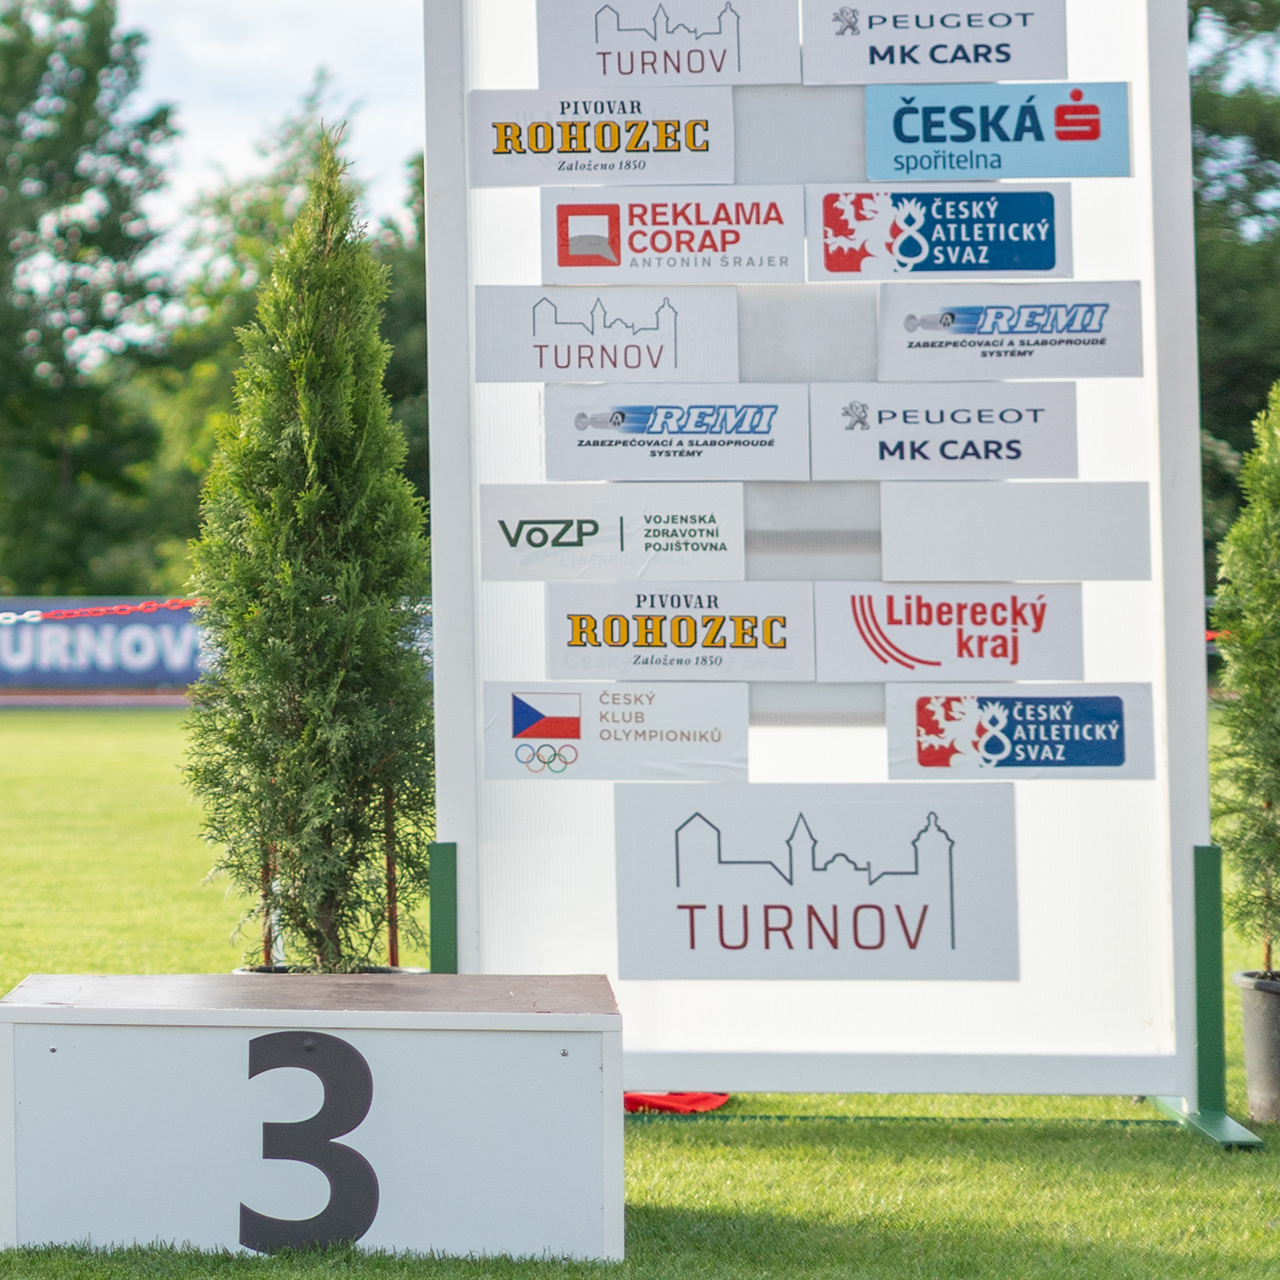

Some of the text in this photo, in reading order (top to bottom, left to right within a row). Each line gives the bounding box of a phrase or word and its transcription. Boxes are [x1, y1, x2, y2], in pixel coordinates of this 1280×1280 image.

[868, 12, 1035, 30] PEUGEOT
[596, 48, 728, 76] TURNOV
[869, 43, 1012, 65] MK CARS
[558, 99, 643, 116] PIVOVAR
[892, 95, 1046, 144] ČESKÁ
[492, 119, 710, 155] ROHOZEC
[557, 159, 647, 172] Založeno 1850
[893, 149, 1002, 174] spořitelna
[627, 201, 785, 227] REKLAMA
[930, 196, 999, 220] ČESKÝ
[930, 218, 1050, 242] ATLETICKÝ
[627, 228, 741, 254] CORAP
[628, 253, 790, 269] ANTONÍN ŠRAJER
[933, 245, 990, 265] SVAZ
[976, 302, 1110, 335] REMI
[906, 336, 1108, 348] ZABEZPEČOVACÍ A SLABOPROUDÉ
[532, 343, 664, 370] TURNOV
[980, 348, 1035, 358] SYSTÉMY
[645, 404, 779, 435] REMI
[877, 408, 1045, 425] PEUGEOT
[576, 437, 776, 448] ZABEZPEČOVACÍ A SLABOPROUDÉ
[649, 448, 704, 458] SYSTÉMY
[878, 439, 1023, 461] MK CARS
[643, 512, 718, 525] VOJENSKÁ
[643, 526, 720, 539] ZDRAVOTNÍ
[644, 539, 728, 553] POJIŠŤOVNA
[635, 593, 720, 610] PIVOVAR
[886, 594, 1048, 634] Liberecký
[567, 613, 788, 649] ROHOZEC
[956, 627, 1019, 666] kraj
[632, 654, 691, 666] Založeno
[694, 654, 723, 666] 1850
[599, 690, 656, 706] ČESKÝ
[599, 711, 645, 724] KLUB
[1012, 701, 1074, 722] ČESKÝ
[599, 727, 723, 744] OLYMPIONIKŮ
[1013, 720, 1119, 742] ATLETICKÝ
[1014, 744, 1066, 762] SVAZ
[676, 903, 929, 950] TURNOV
[238, 1030, 381, 1257] 3
